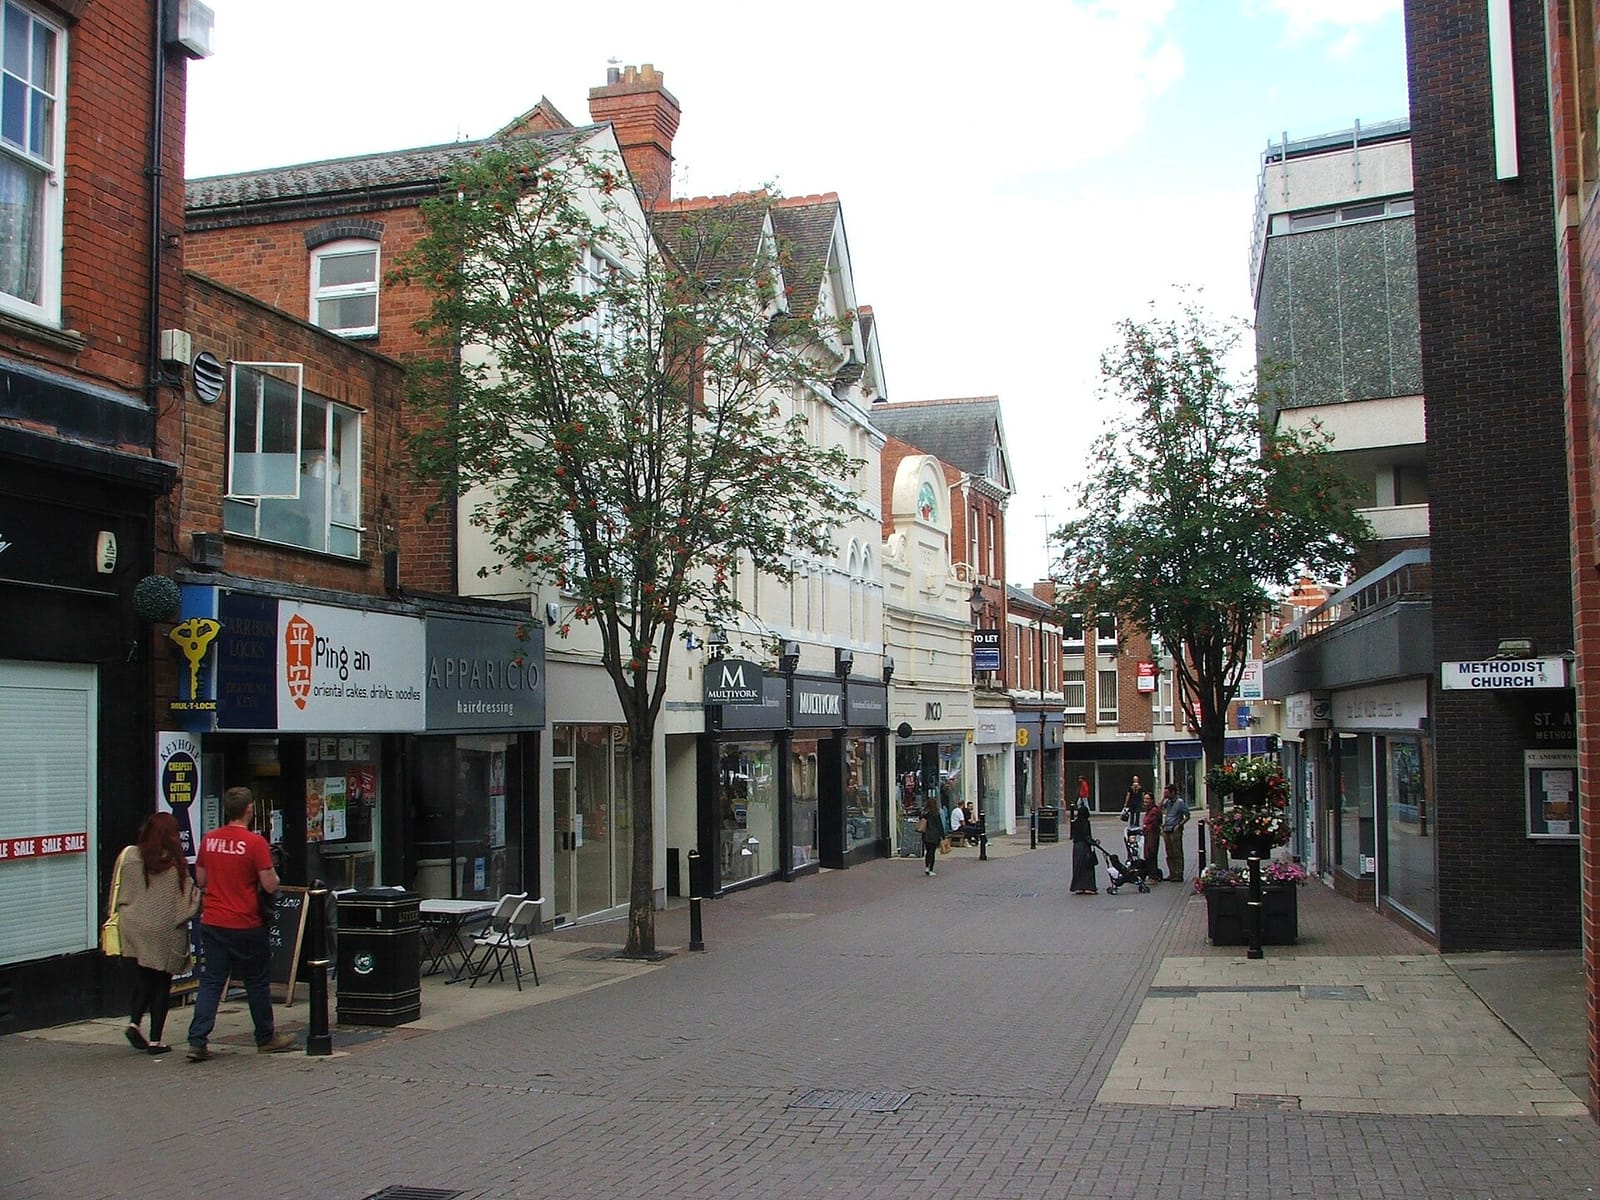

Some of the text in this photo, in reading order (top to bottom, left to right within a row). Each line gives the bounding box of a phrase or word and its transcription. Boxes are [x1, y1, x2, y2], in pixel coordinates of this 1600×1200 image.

[984, 634, 999, 643] LET
[315, 636, 371, 681] Ping an
[427, 657, 540, 691] APPARICIO
[1459, 662, 1545, 674] METHODIST
[720, 665, 747, 688] M
[1471, 676, 1534, 687] CHURCH
[314, 683, 345, 697] oriental
[707, 690, 758, 700] MULTIYORK
[457, 700, 514, 716] hairdressing
[799, 692, 841, 714] MULTIYORK
[14, 841, 35, 856] SALE
[42, 838, 62, 853] SALE
[65, 836, 85, 851] SALE
[206, 838, 247, 855] WILLS
